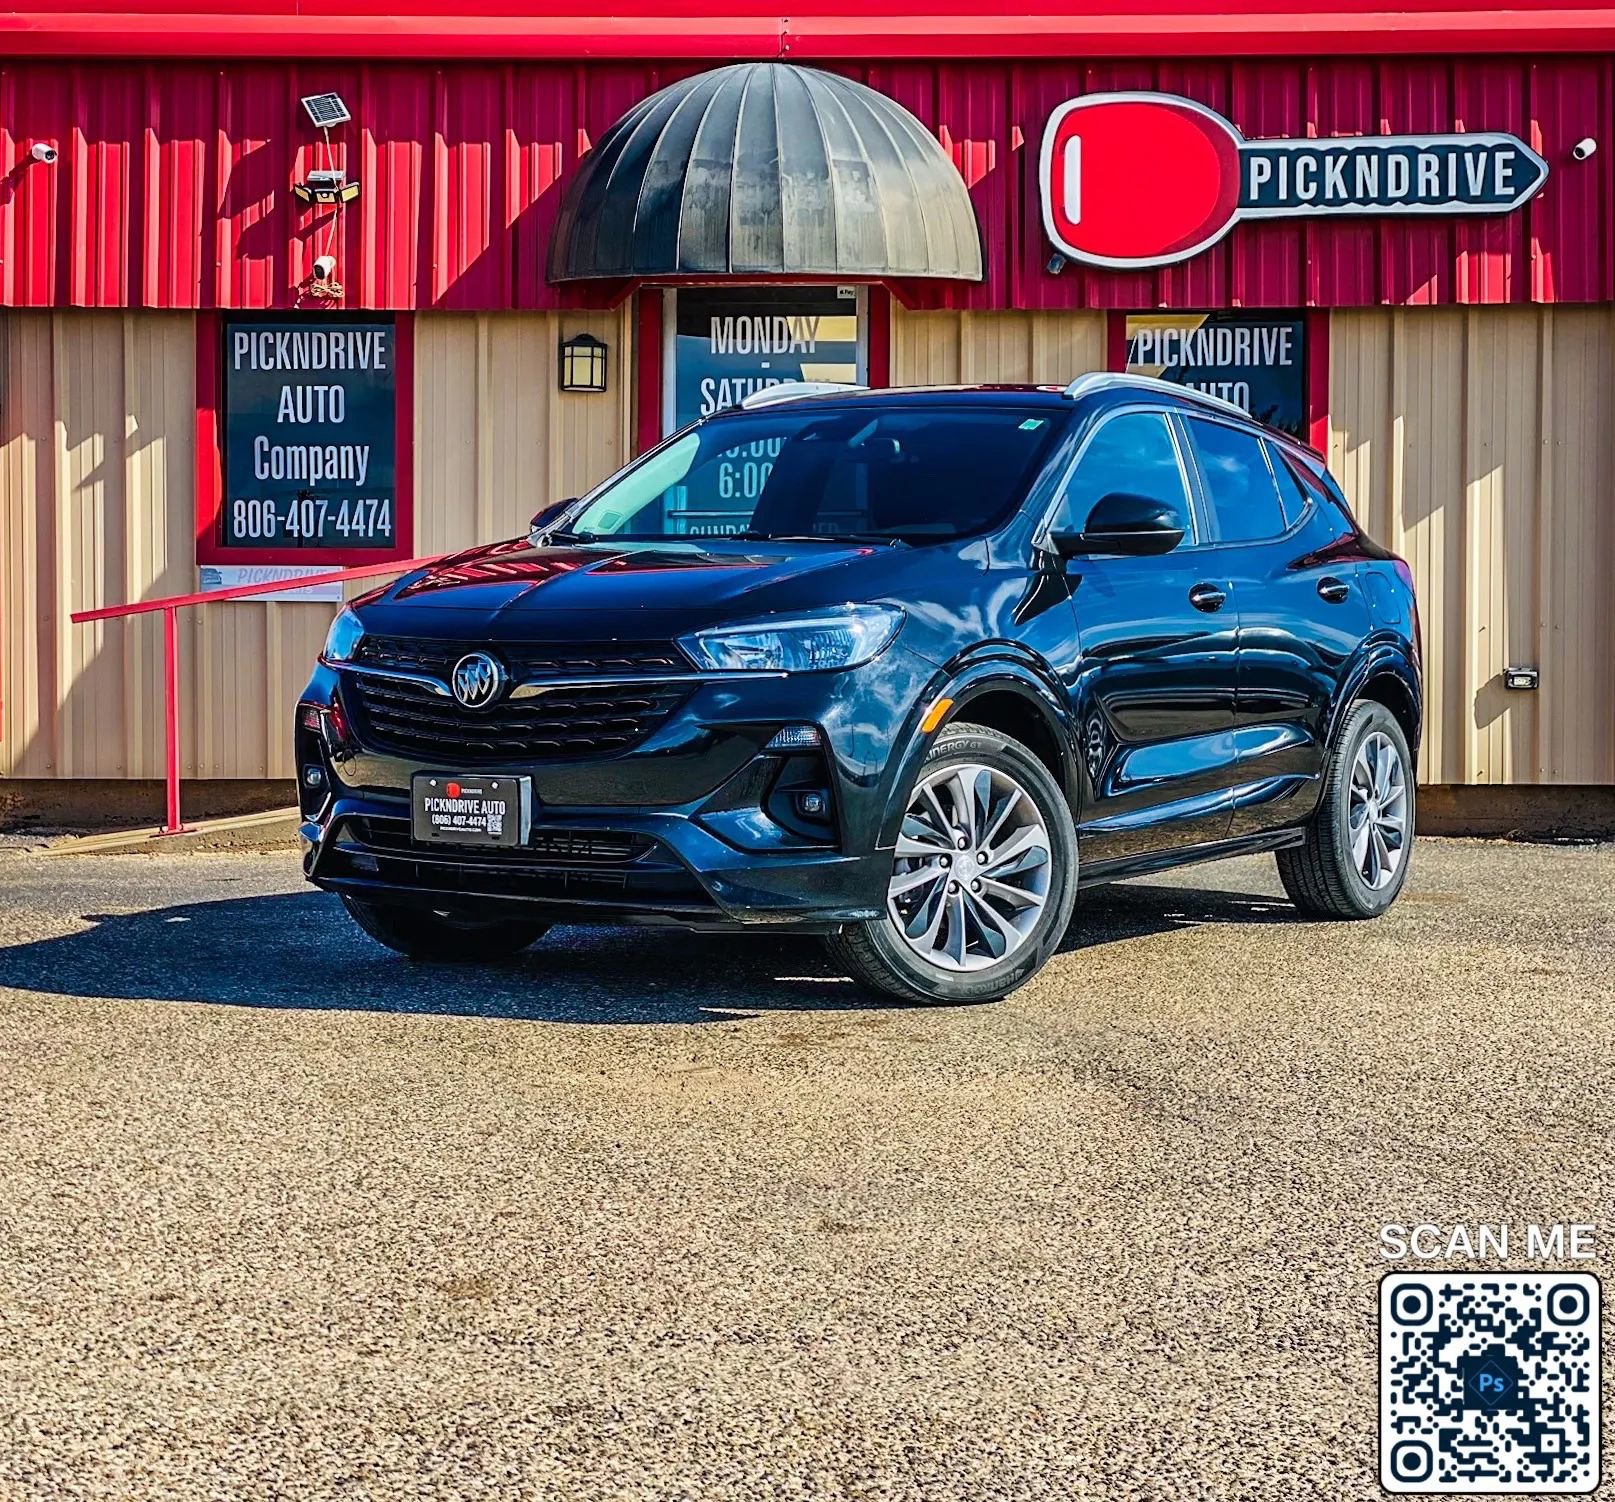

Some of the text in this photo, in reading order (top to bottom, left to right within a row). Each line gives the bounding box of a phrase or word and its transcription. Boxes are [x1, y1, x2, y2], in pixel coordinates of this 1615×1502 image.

[1249, 151, 1516, 201] PICKNDRIVE
[233, 331, 387, 370] PICKNDRIVE
[710, 316, 821, 354] MONDAY
[1137, 327, 1292, 366] PICKNDRIVE
[277, 385, 345, 423] AUTO
[253, 435, 369, 486] Company
[233, 499, 391, 538] 806-407-4474
[424, 797, 506, 815] PICKNDRIVE AUTO
[452, 815, 487, 827] 407-4474
